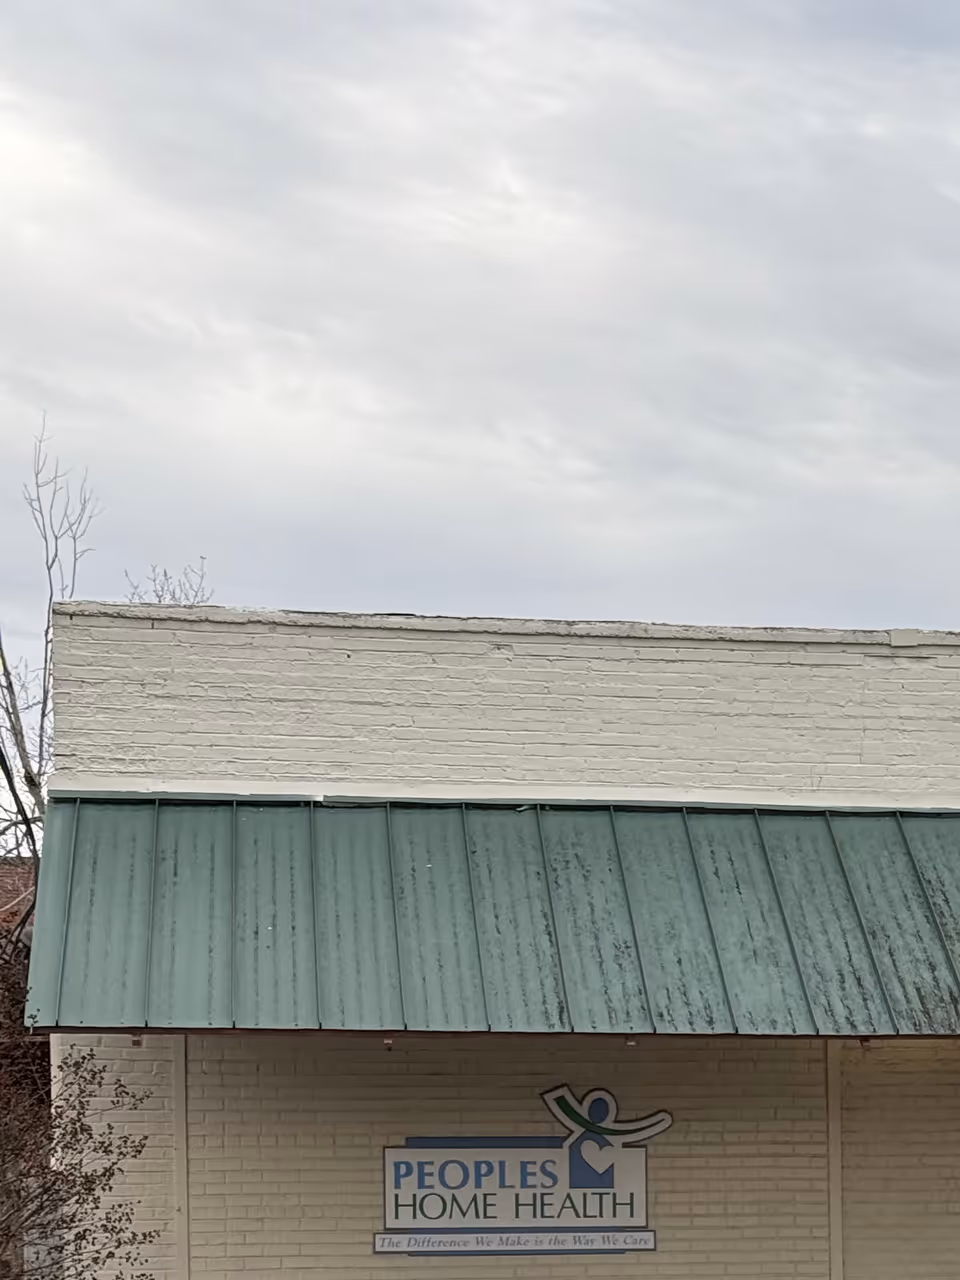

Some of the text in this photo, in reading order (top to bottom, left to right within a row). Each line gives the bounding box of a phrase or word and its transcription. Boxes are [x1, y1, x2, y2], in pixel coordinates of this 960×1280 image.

[393, 1160, 559, 1190] PEOPLES
[394, 1192, 634, 1219] HOME HEALTH
[380, 1234, 650, 1248] The Difference We Make is the Way We Care
